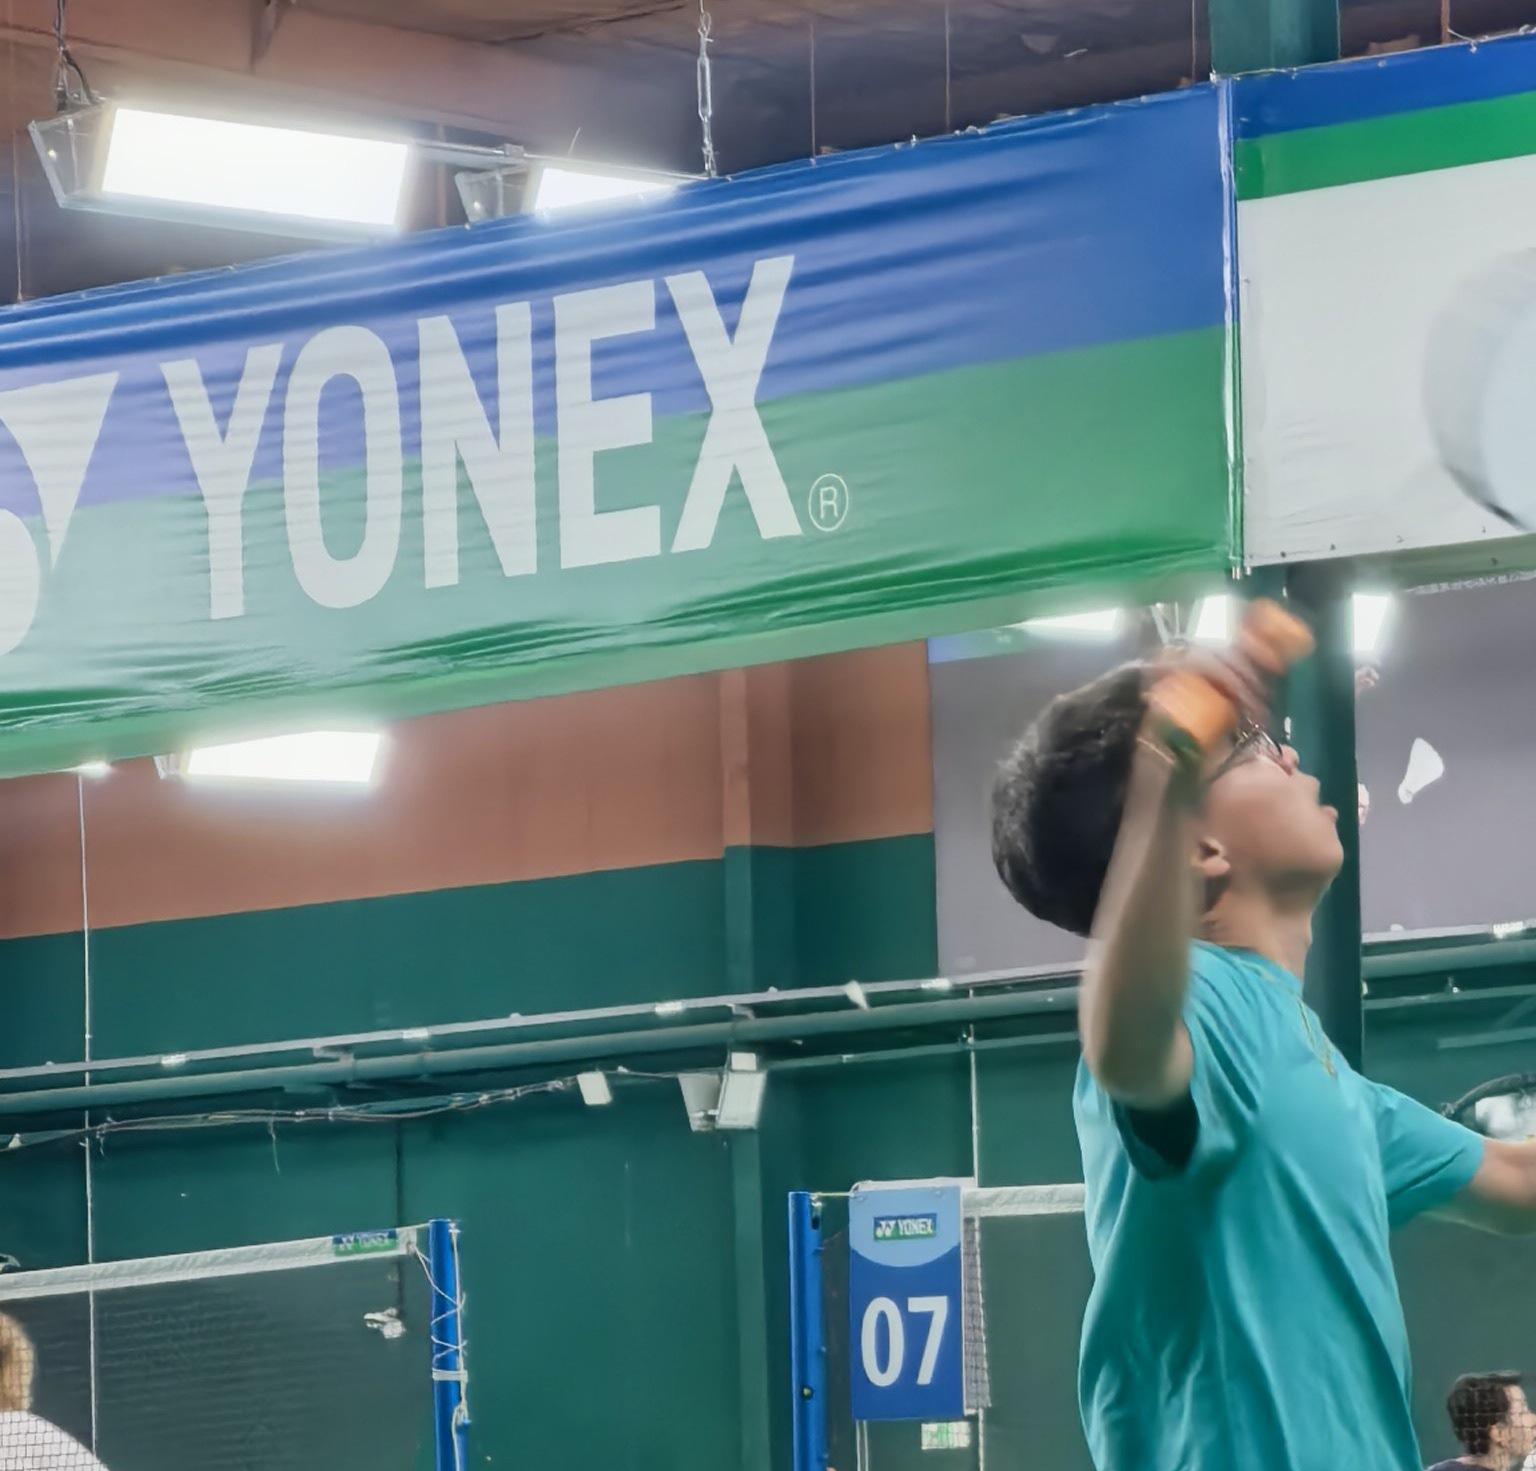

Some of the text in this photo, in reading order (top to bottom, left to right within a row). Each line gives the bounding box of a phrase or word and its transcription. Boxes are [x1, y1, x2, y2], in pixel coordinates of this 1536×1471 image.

[160, 255, 802, 619] YONEX
[898, 1218, 933, 1236] YONEX
[861, 1296, 948, 1387] 07
